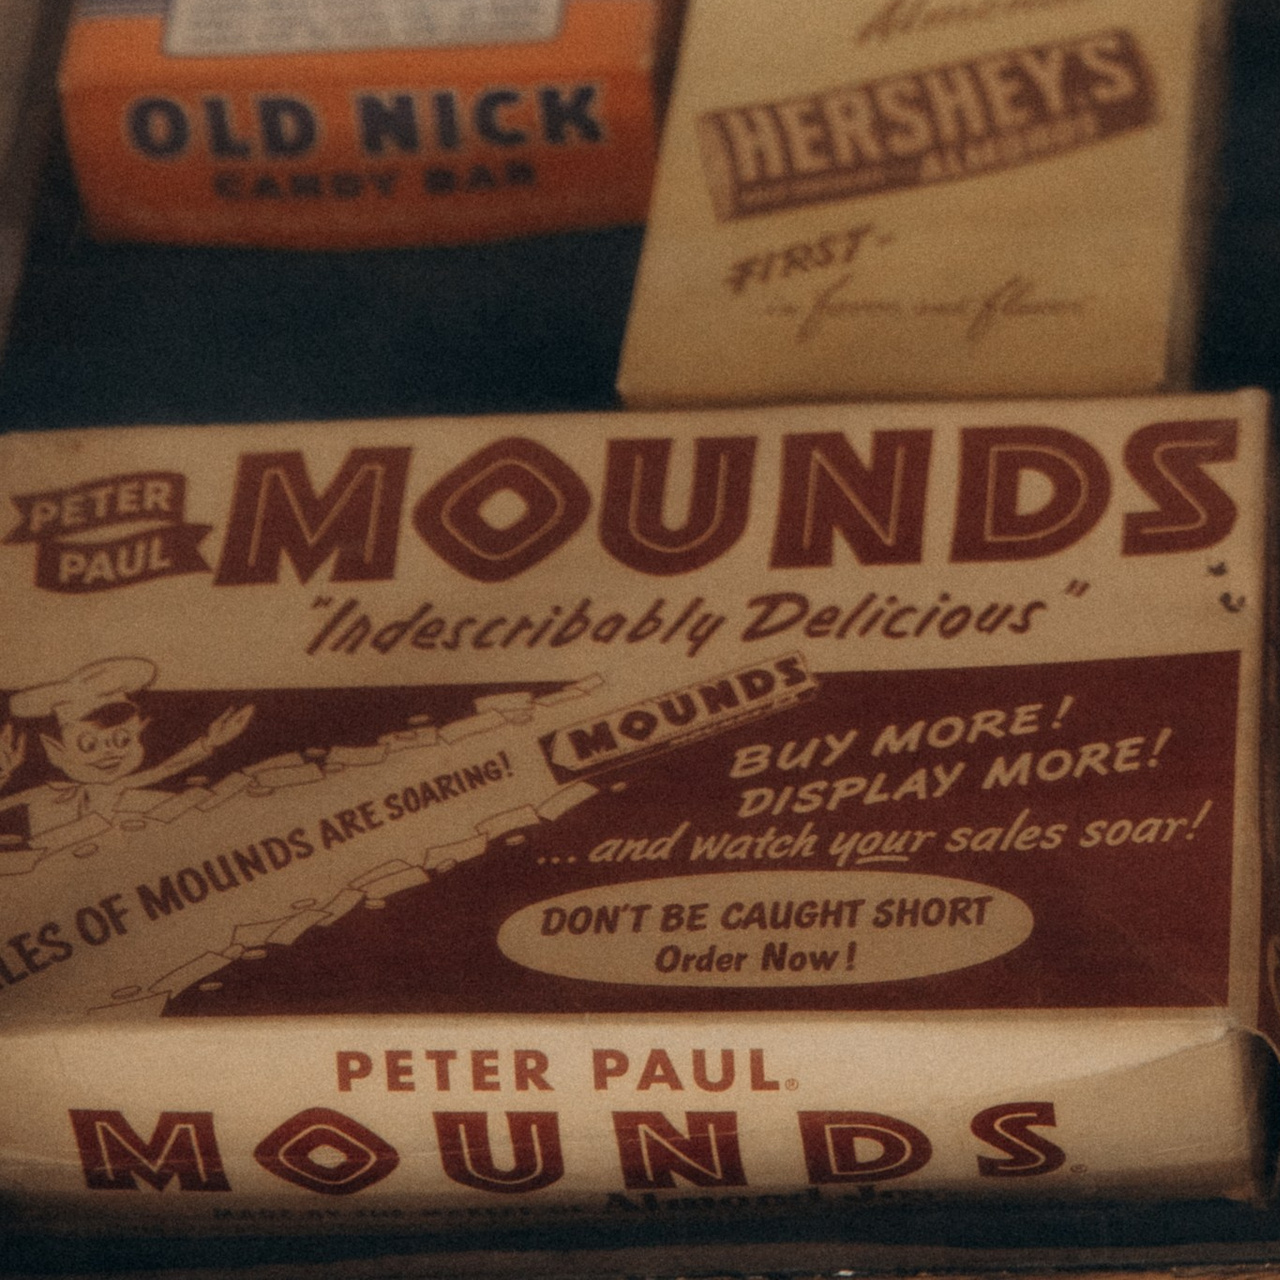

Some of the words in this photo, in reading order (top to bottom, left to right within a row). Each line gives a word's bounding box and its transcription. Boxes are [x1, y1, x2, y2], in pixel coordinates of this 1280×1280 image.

[126, 94, 319, 163] OLD
[354, 83, 606, 159] NICK
[28, 479, 172, 532] PETER
[213, 417, 1242, 587] MOUNDS
[57, 538, 173, 583] PAUL
[571, 655, 811, 762] MOUNDS
[729, 729, 859, 780] BUY
[878, 695, 1077, 759] MORE!
[737, 760, 966, 819] DISPLAY
[981, 726, 1173, 793] MORE!
[0, 921, 74, 991] LES
[74, 892, 129, 946] OF
[134, 827, 316, 921] MOUNDS
[320, 802, 383, 852] ARE
[382, 750, 516, 823] SOARING!
[587, 821, 691, 864] and
[690, 820, 815, 864] watch
[829, 825, 930, 868] your
[943, 808, 1063, 855] sales
[1078, 800, 1213, 848] soar!
[540, 902, 652, 938] DON'T
[658, 901, 710, 934] BE
[718, 897, 867, 934] CAUGHT
[871, 893, 995, 930] SHORT
[655, 943, 748, 975] Order
[760, 941, 858, 975] Now!
[336, 1047, 555, 1093] PETER
[67, 1100, 1068, 1194] MOUNDS
